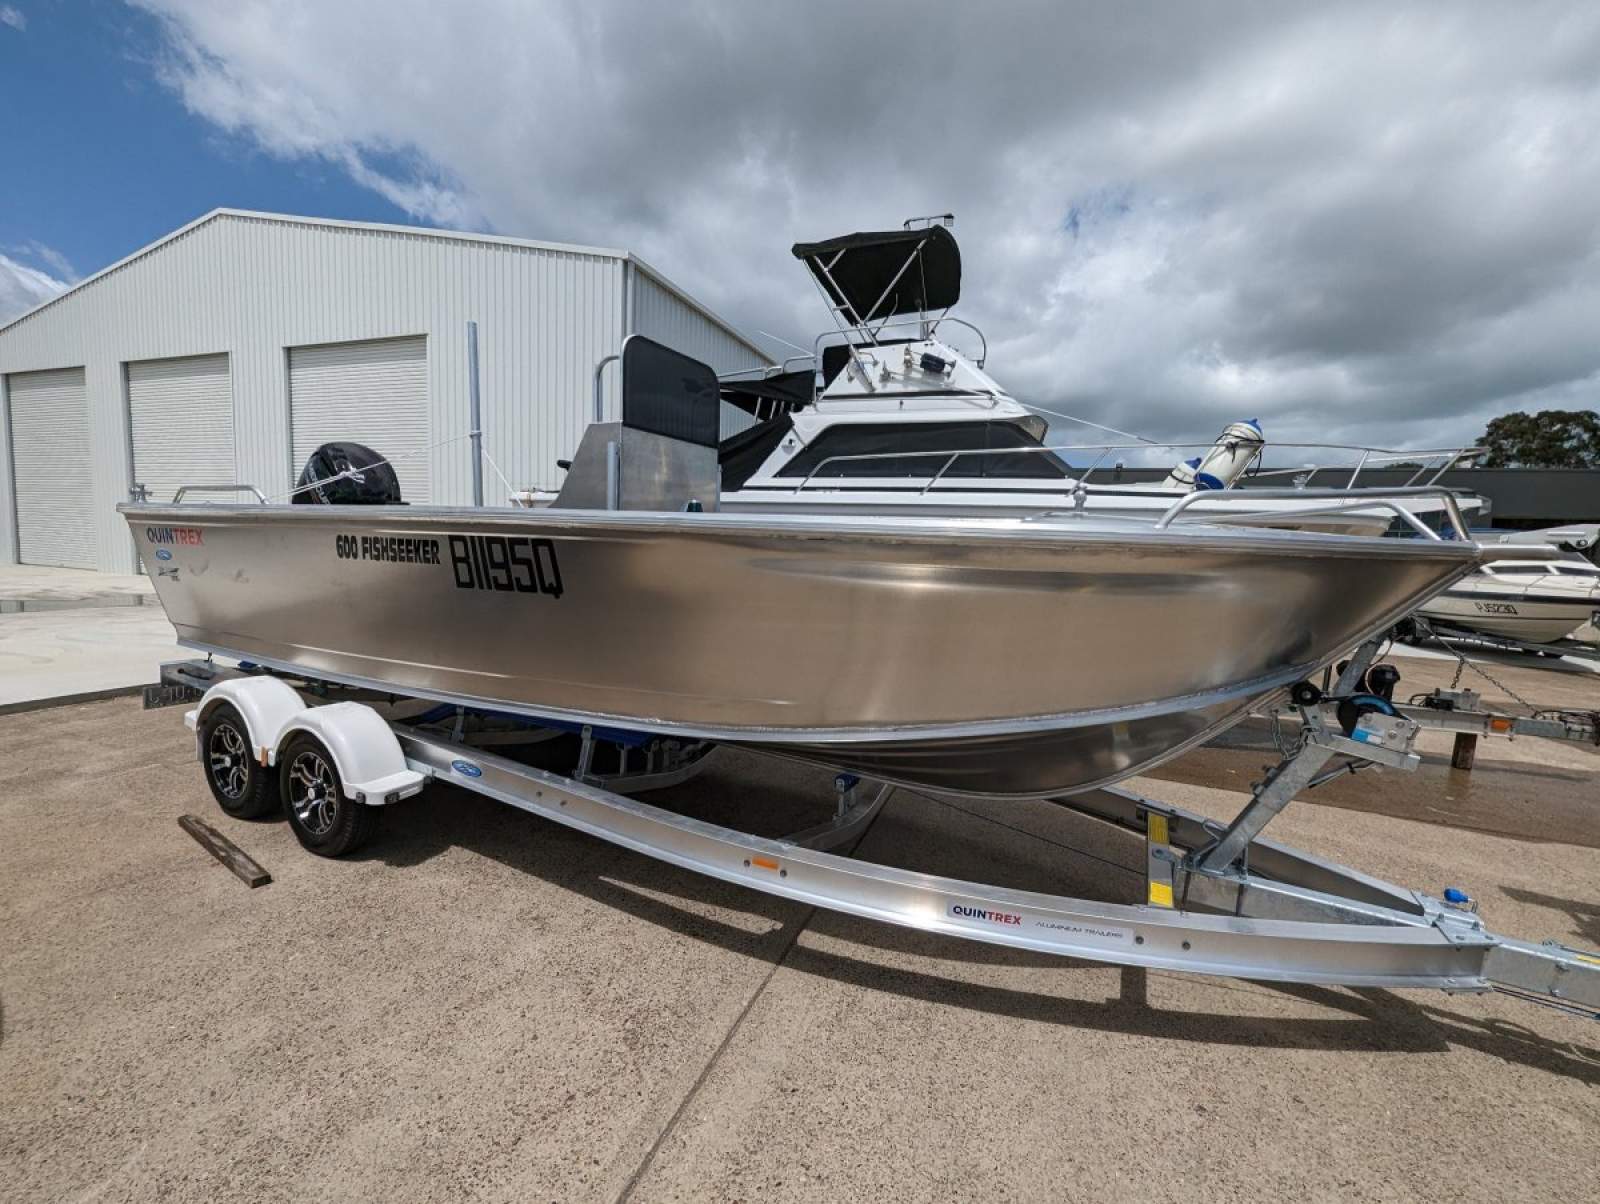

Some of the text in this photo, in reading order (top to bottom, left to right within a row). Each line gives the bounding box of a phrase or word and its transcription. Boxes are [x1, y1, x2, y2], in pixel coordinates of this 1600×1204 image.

[147, 527, 205, 545] QUINTREX
[336, 535, 440, 565] 600 FISHSEEKER
[952, 905, 1022, 926] QUINTREX
